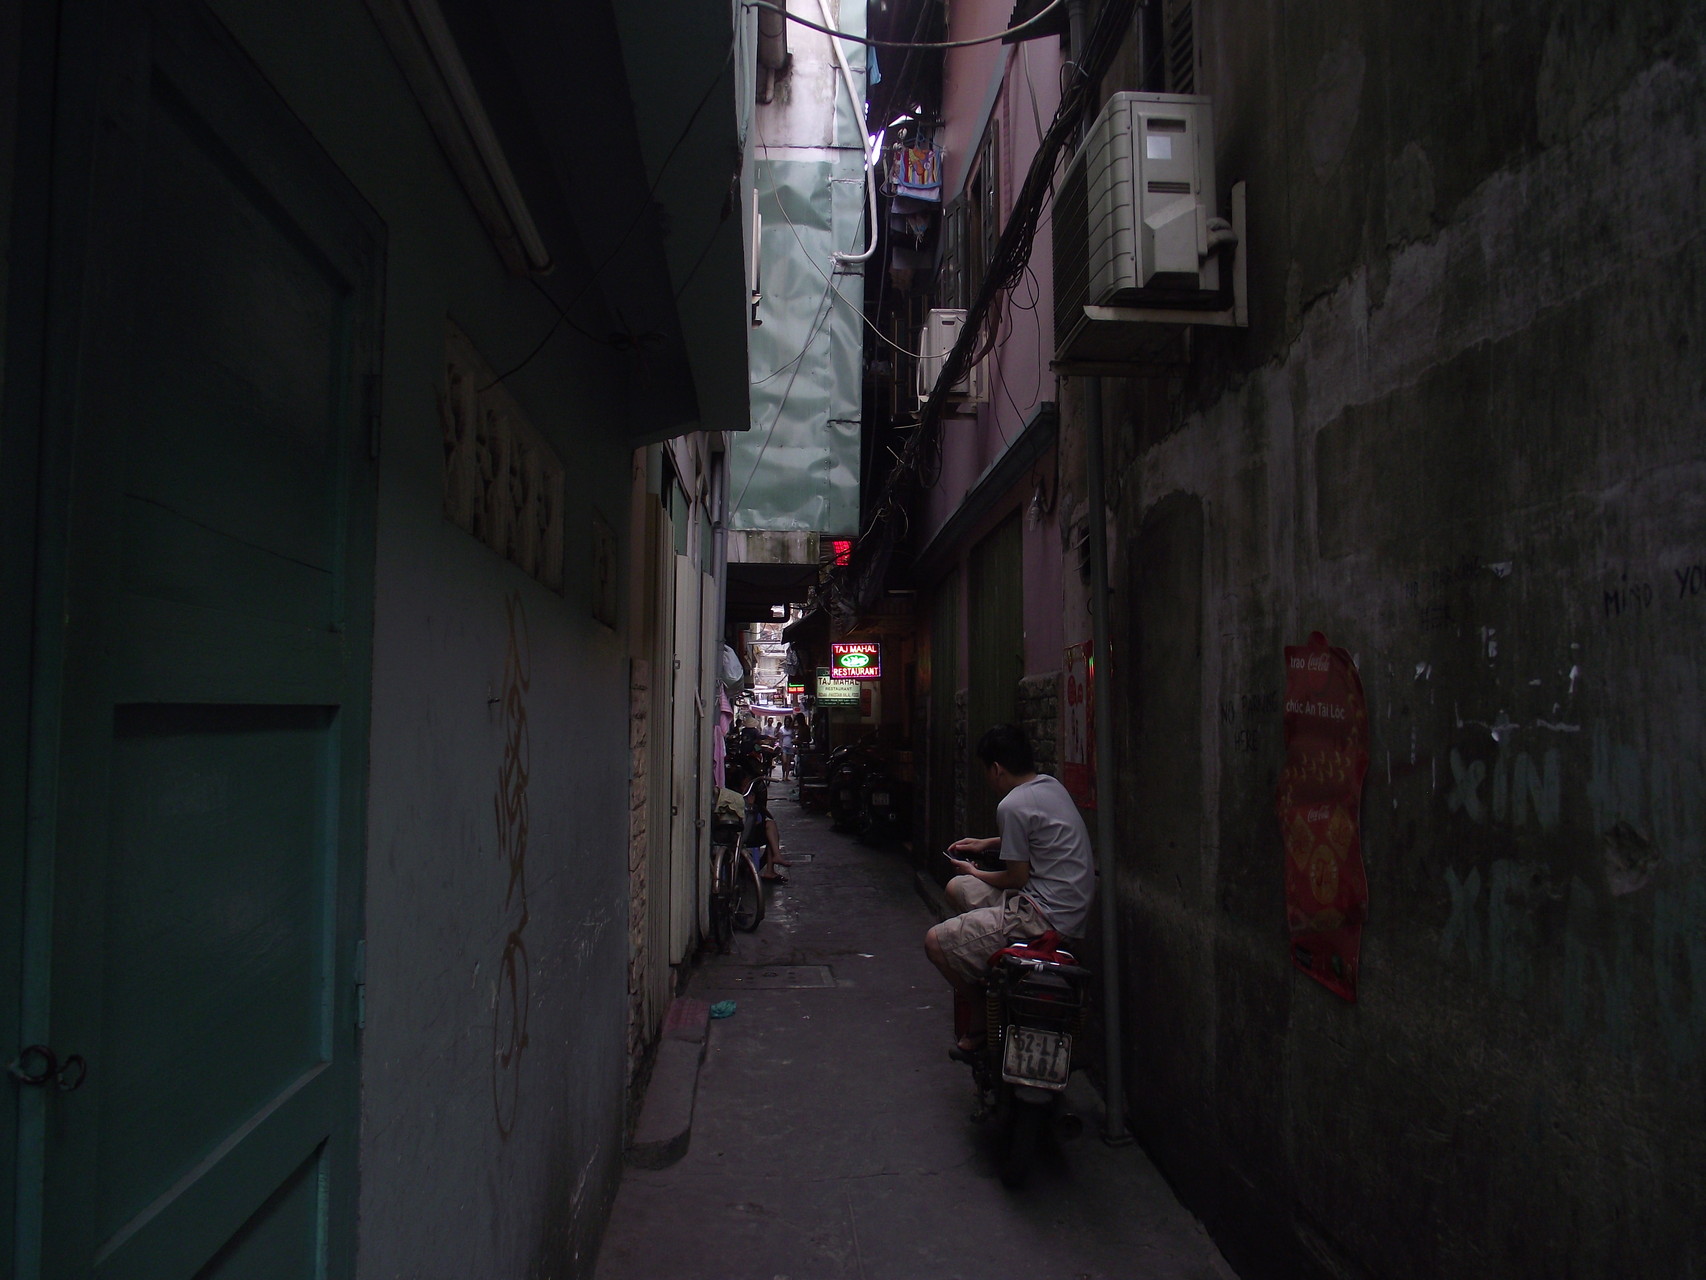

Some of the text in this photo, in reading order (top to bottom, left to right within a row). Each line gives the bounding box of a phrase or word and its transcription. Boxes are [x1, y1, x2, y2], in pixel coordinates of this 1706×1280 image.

[1675, 565, 1706, 600] YO
[834, 645, 877, 653] TAJ MAHAL
[1290, 657, 1305, 669] trao
[833, 667, 879, 676] RESTAURANT
[1305, 700, 1316, 716] An
